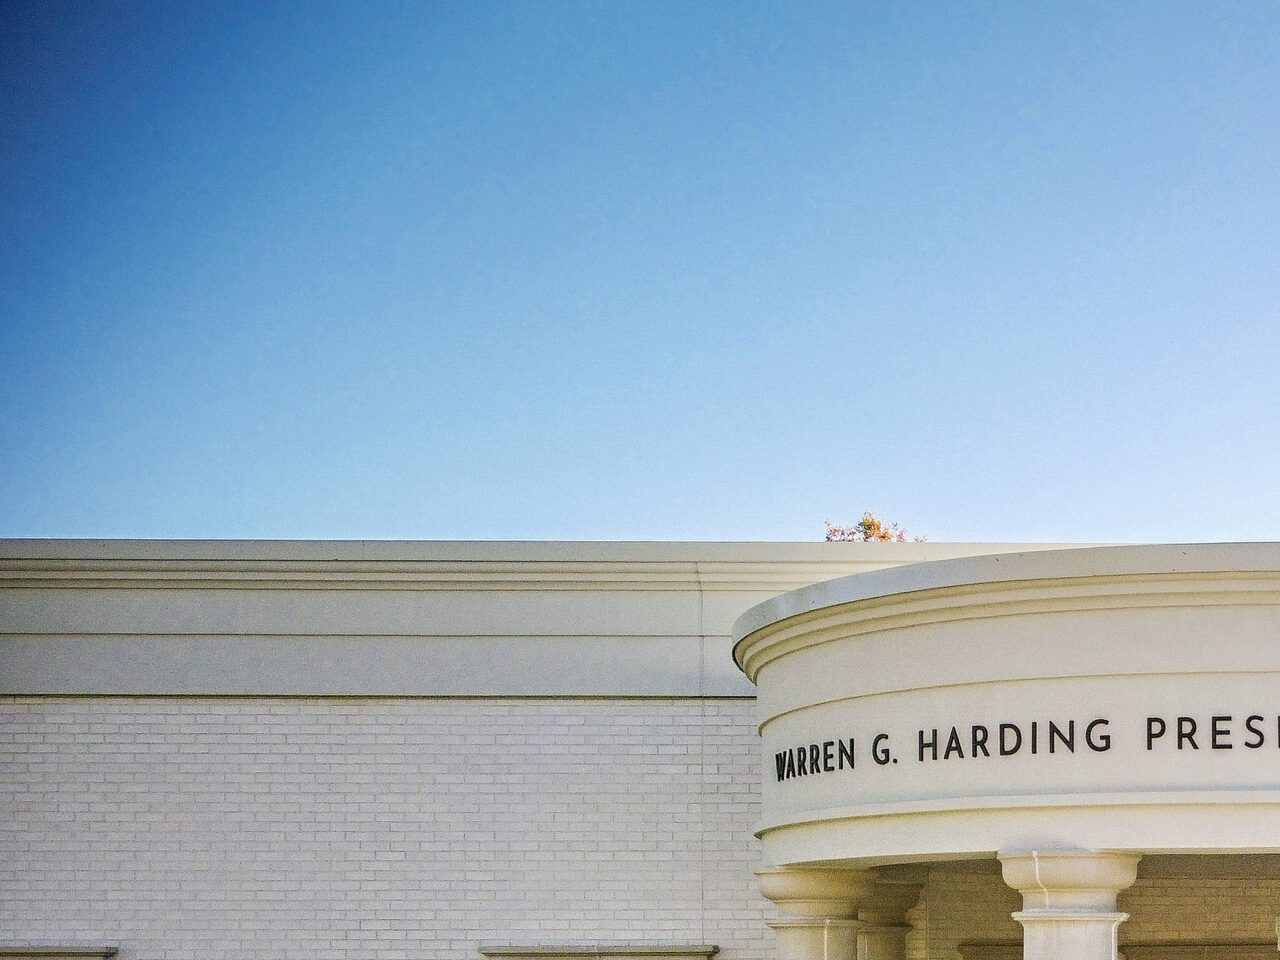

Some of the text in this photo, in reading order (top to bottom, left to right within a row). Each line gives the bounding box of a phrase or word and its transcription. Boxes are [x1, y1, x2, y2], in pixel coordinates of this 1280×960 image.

[774, 737, 855, 783] WARREN
[871, 733, 898, 766] G.
[918, 718, 1111, 762] HARDING
